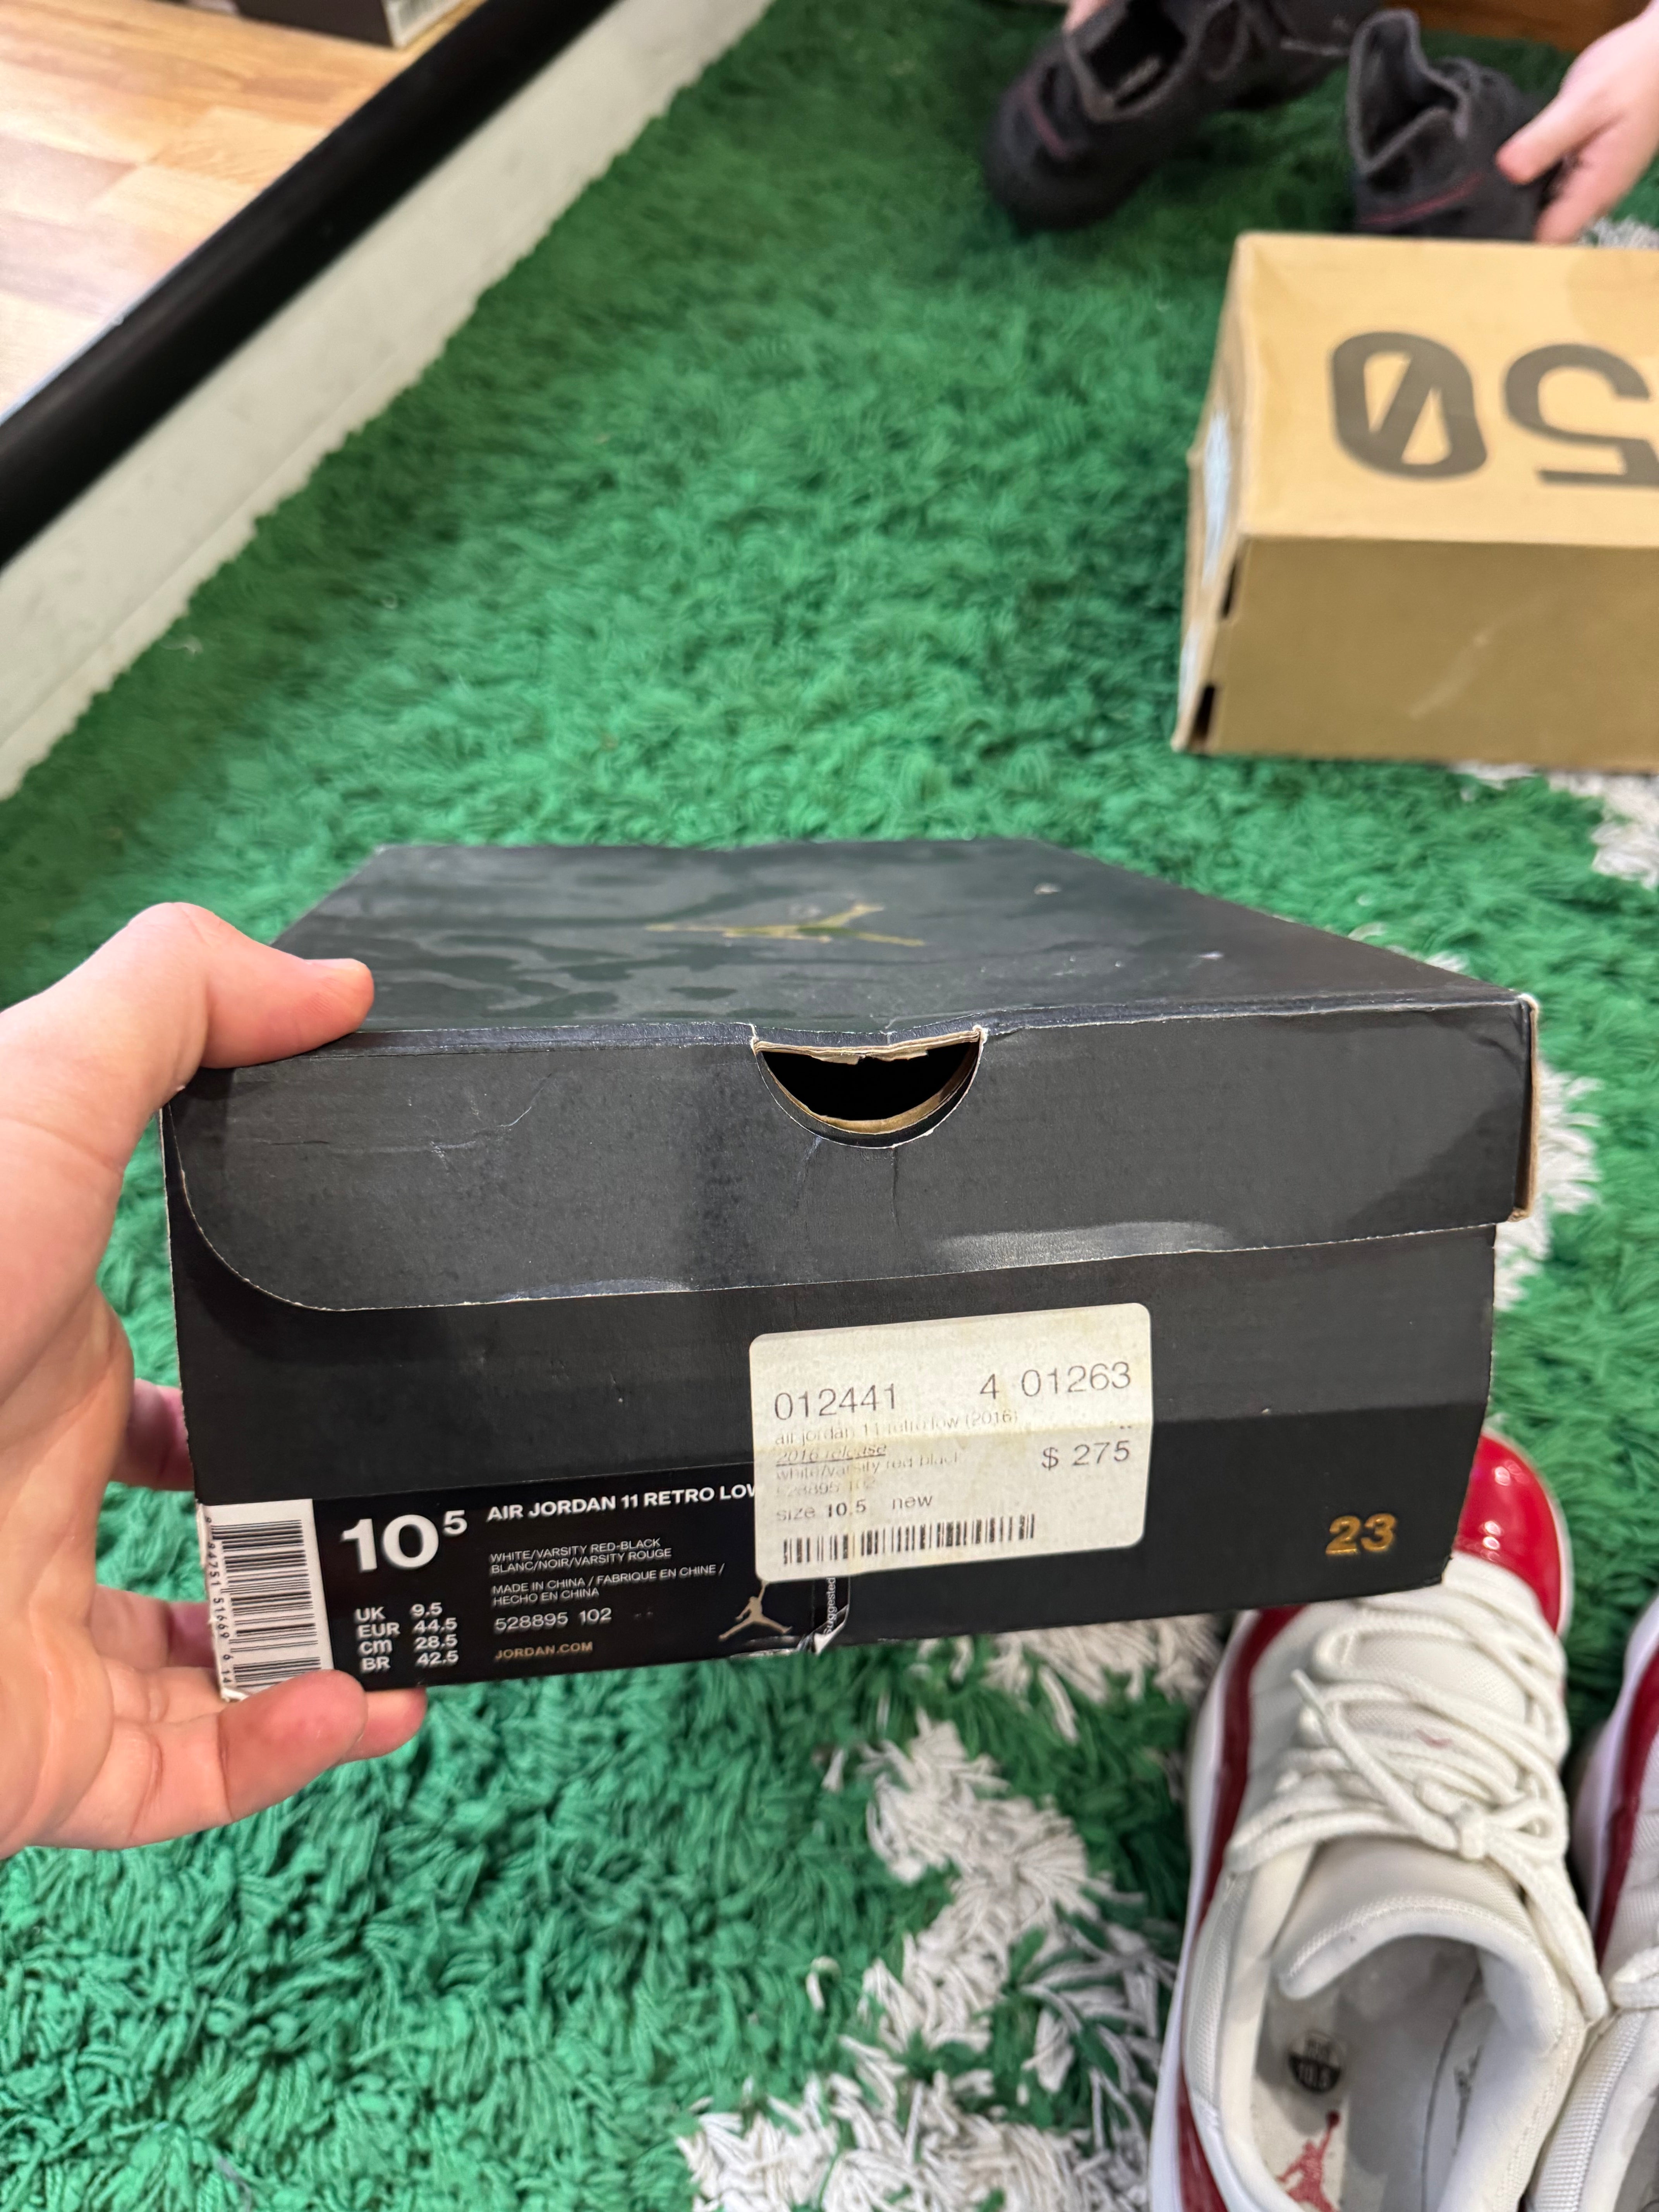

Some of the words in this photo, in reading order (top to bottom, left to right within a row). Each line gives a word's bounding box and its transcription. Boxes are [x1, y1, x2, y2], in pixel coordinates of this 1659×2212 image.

[775, 1383, 895, 1420] 012441
[980, 1374, 1000, 1400] 4
[1021, 1361, 1131, 1397] 01263
[965, 1409, 1018, 1429] (2016)
[1041, 1447, 1059, 1470] $
[1072, 1440, 1130, 1466] 275
[486, 1504, 524, 1523] AIR
[528, 1495, 616, 1519] JORDAN
[621, 1494, 639, 1510] 11
[643, 1487, 715, 1508] RETRO
[776, 1506, 816, 1521] size
[827, 1498, 867, 1518] 10.5
[892, 1495, 933, 1510] new
[1325, 1513, 1397, 1556] 23
[489, 1544, 587, 1563] WHITE/VARSITY
[590, 1537, 661, 1554] RED-BLACK
[489, 1552, 625, 1576] BLANC/NOIR/VARSITY
[627, 1548, 672, 1564] ROUGE
[491, 1582, 529, 1596] MADE
[531, 1581, 544, 1592] IN
[546, 1577, 586, 1590] CHINA
[587, 1575, 594, 1588] /
[596, 1570, 657, 1587] FABRIQUE
[659, 1568, 677, 1581] EN
[678, 1565, 716, 1579] CHINE
[718, 1563, 725, 1576] /
[491, 1592, 538, 1607] HECHO
[540, 1591, 558, 1603] EN
[560, 1587, 599, 1601] CHINA
[213, 1597, 230, 1639] 51669
[354, 1607, 386, 1623] UK
[409, 1602, 443, 1620] 9.5
[493, 1612, 569, 1634] 528895
[578, 1607, 612, 1625] 102
[356, 1622, 401, 1641] EUR
[411, 1617, 458, 1634] 44.5
[357, 1639, 393, 1656] cm
[413, 1633, 458, 1652] 28.5
[493, 1641, 593, 1662] JORDAN.COM
[360, 1656, 391, 1674] BR
[414, 1650, 459, 1668] 42.5
